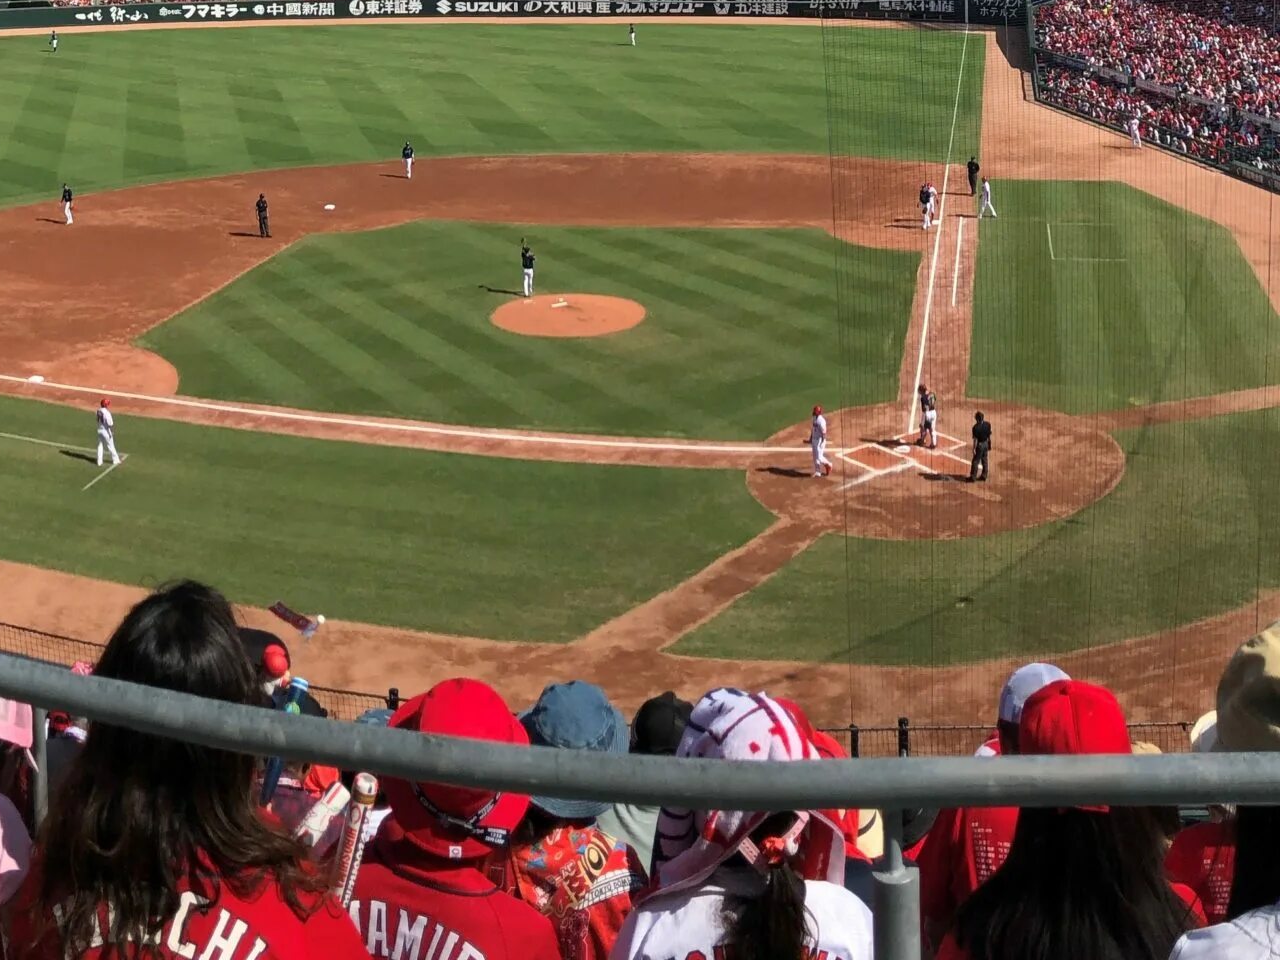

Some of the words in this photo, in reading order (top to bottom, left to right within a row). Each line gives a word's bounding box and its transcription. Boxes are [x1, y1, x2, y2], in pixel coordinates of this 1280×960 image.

[181, 4, 247, 19] フマキラー
[267, 2, 335, 16] 中國新聞
[366, 0, 423, 14] 東洋証券
[455, 1, 519, 13] SUZUKI
[980, 7, 1017, 17] ホテルズ
